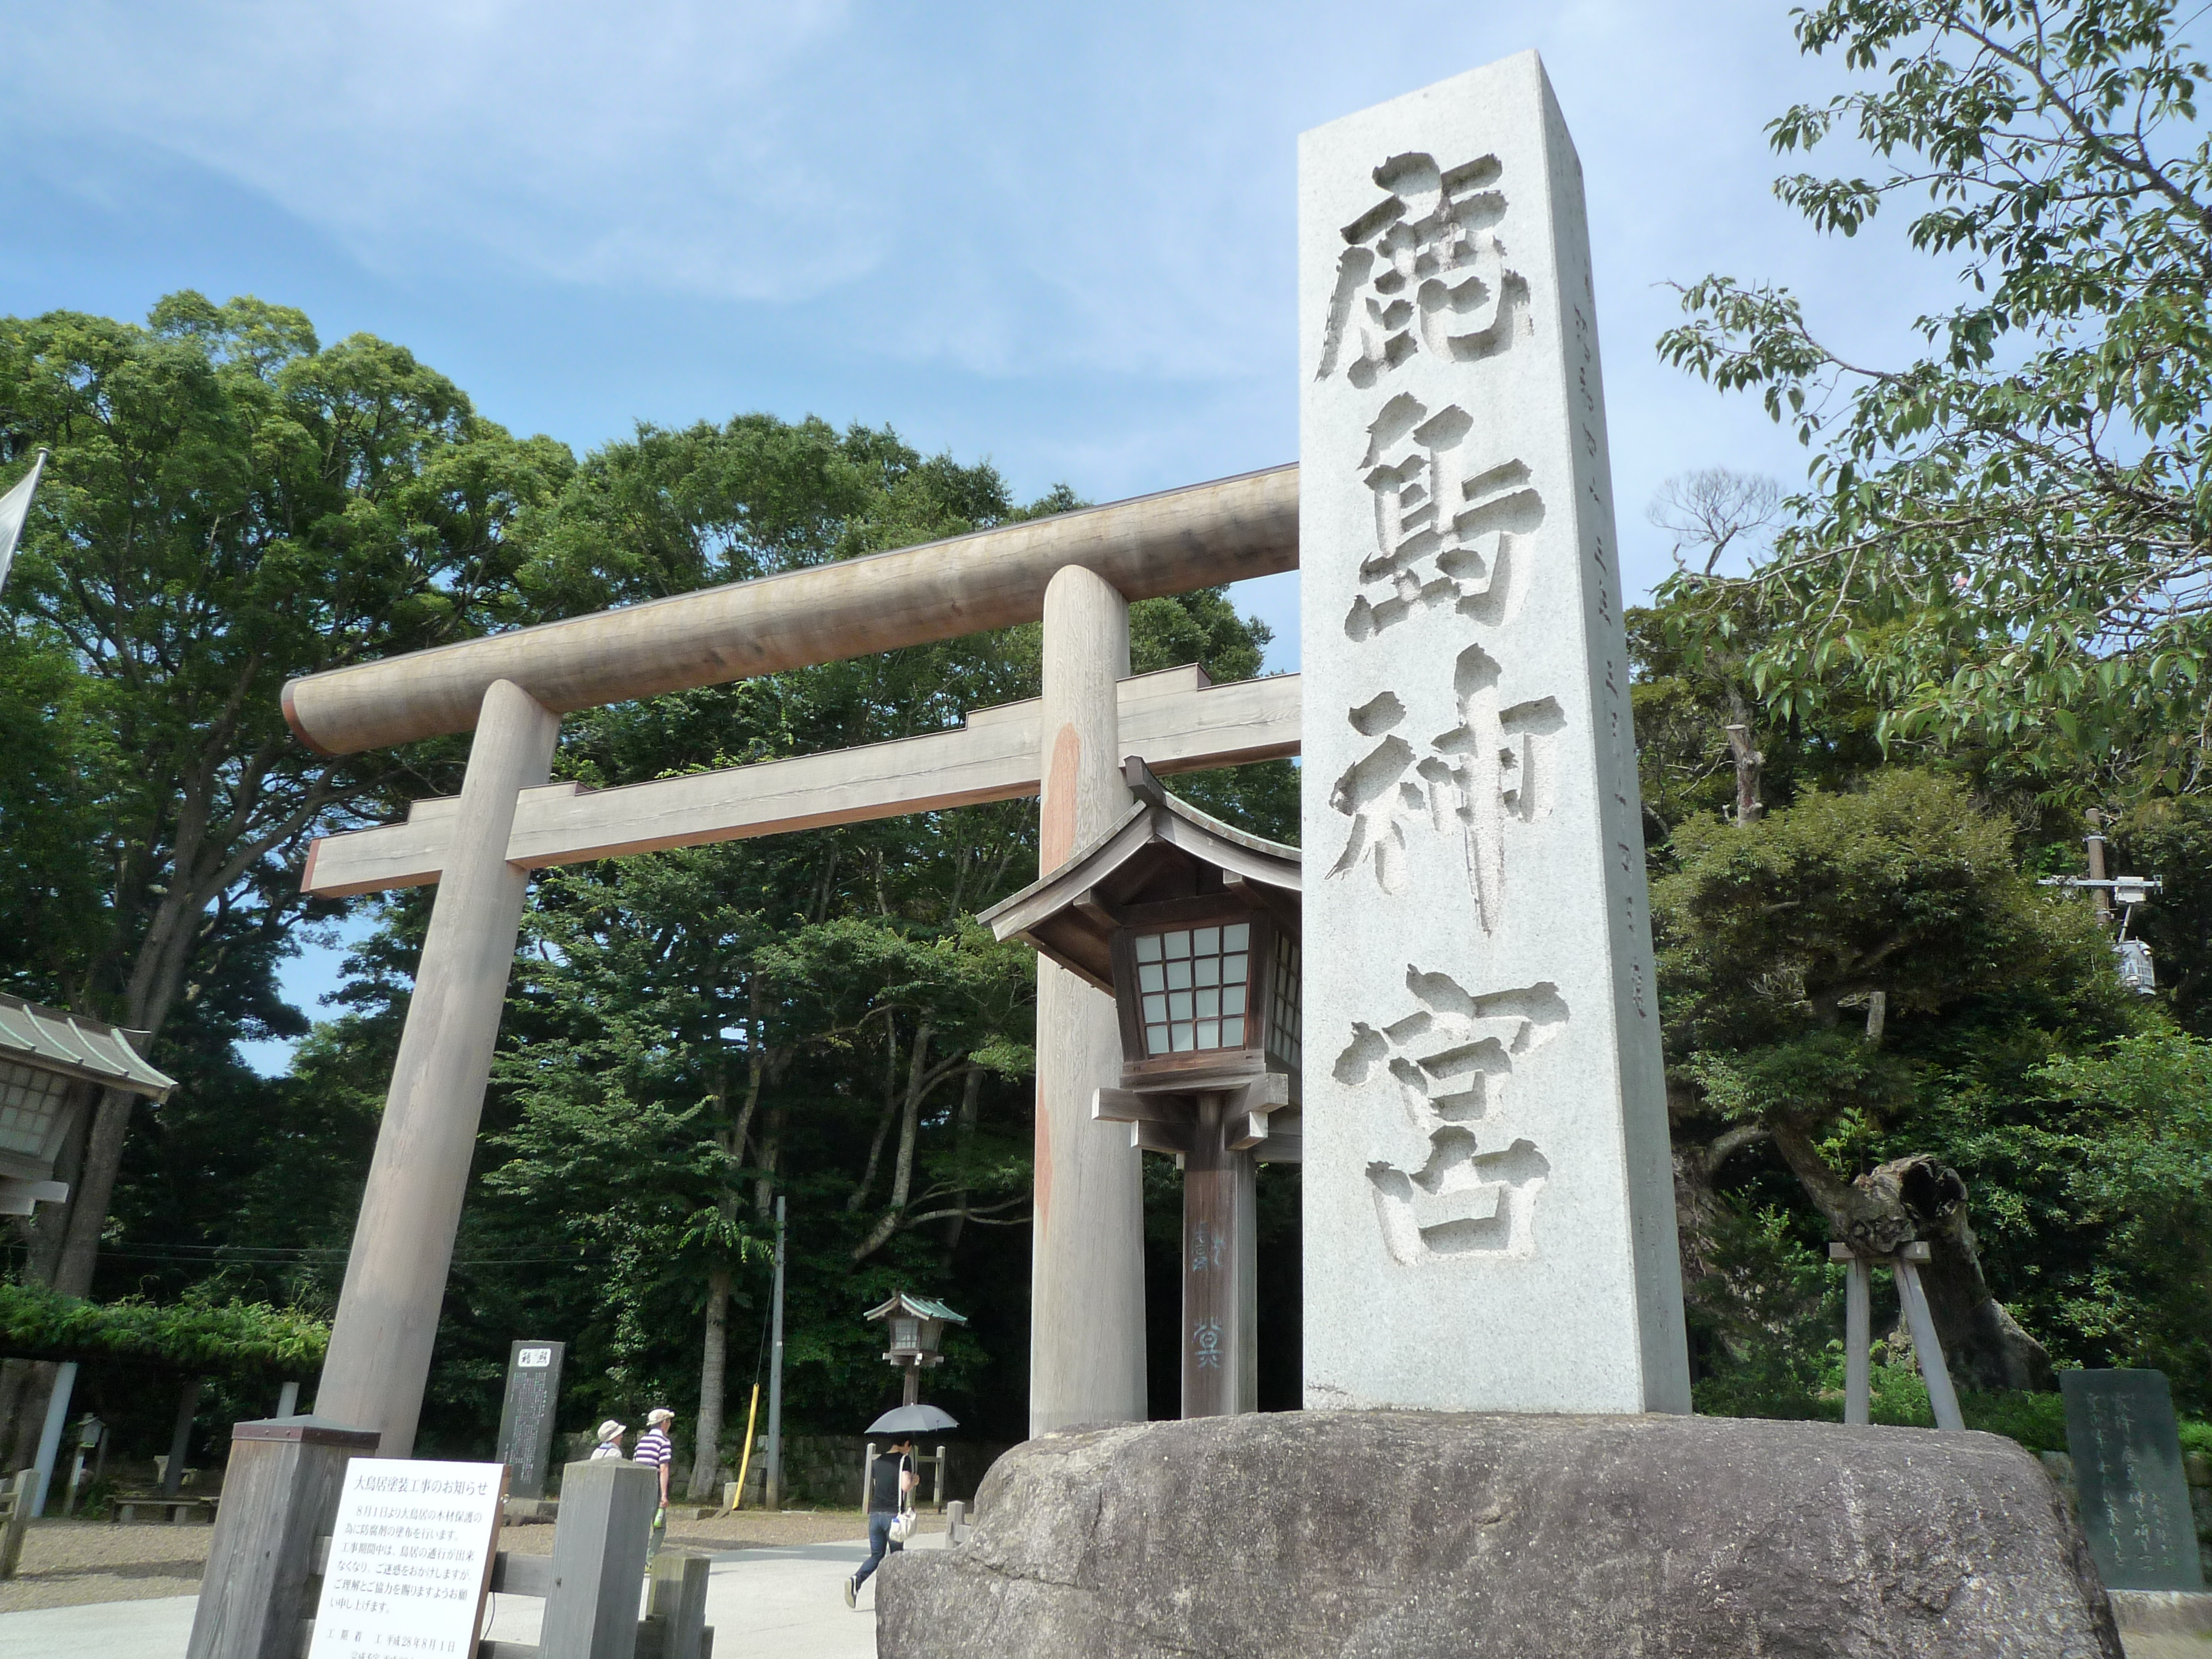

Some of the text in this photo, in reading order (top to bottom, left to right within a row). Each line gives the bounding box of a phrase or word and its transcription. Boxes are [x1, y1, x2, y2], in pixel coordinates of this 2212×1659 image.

[1313, 151, 1570, 1267] 鹿島神宮
[354, 1475, 488, 1496] 大鳥居塗装工事のお知らせ
[357, 1506, 482, 1523] 8月1日より大鳥居の木材保護の
[344, 1523, 458, 1541] 為に防腐剤の塗布を行います。
[341, 1541, 475, 1561] 工事期間中は、鳥居の通行が出来
[337, 1560, 471, 1581] なくなり、ご迷惑をおかけしますが、
[333, 1578, 468, 1601] ご理解とご協力を賜りますようお願
[329, 1597, 389, 1614] い申し上げます。
